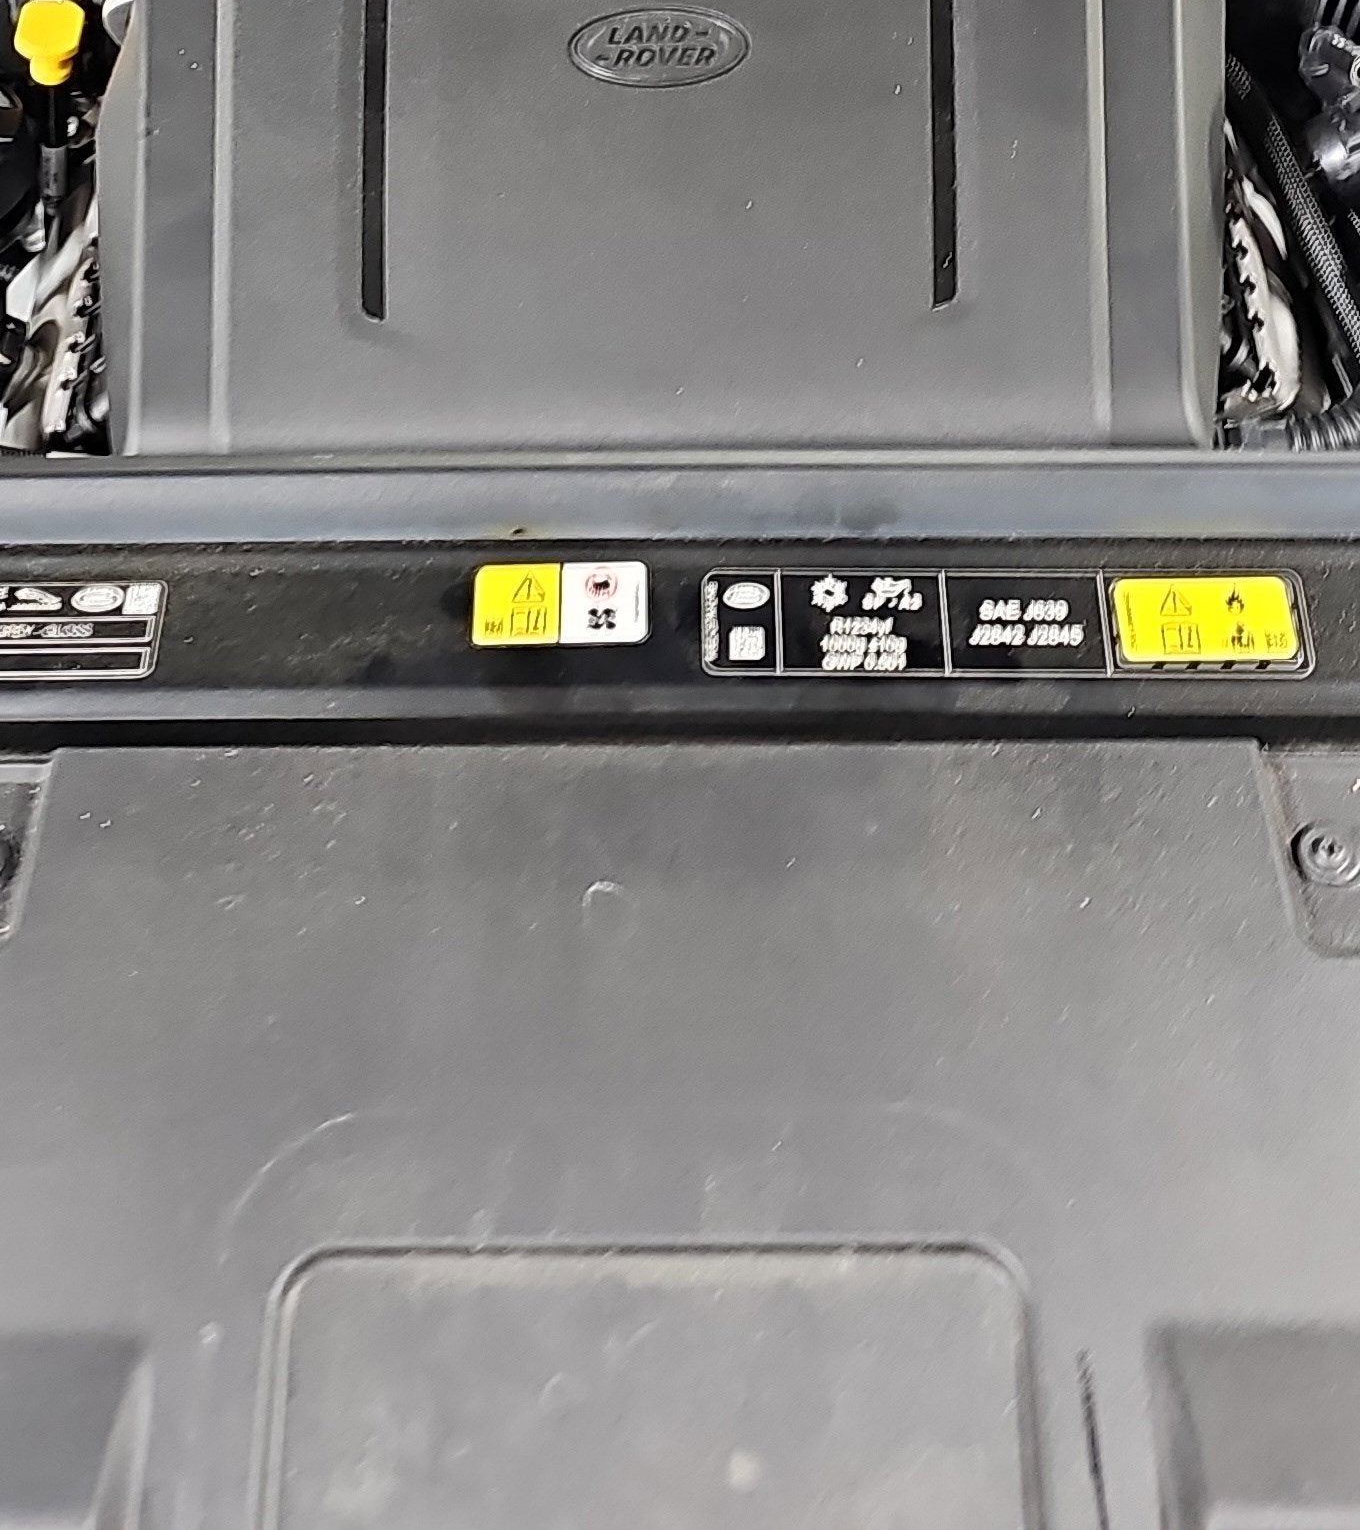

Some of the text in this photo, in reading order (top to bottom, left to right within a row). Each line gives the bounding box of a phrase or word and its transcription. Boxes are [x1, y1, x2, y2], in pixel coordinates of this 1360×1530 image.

[607, 24, 690, 46] LAND
[612, 46, 717, 68] ROVER
[978, 599, 1069, 622] SAE J639
[968, 623, 1085, 647] J2842 J2845
